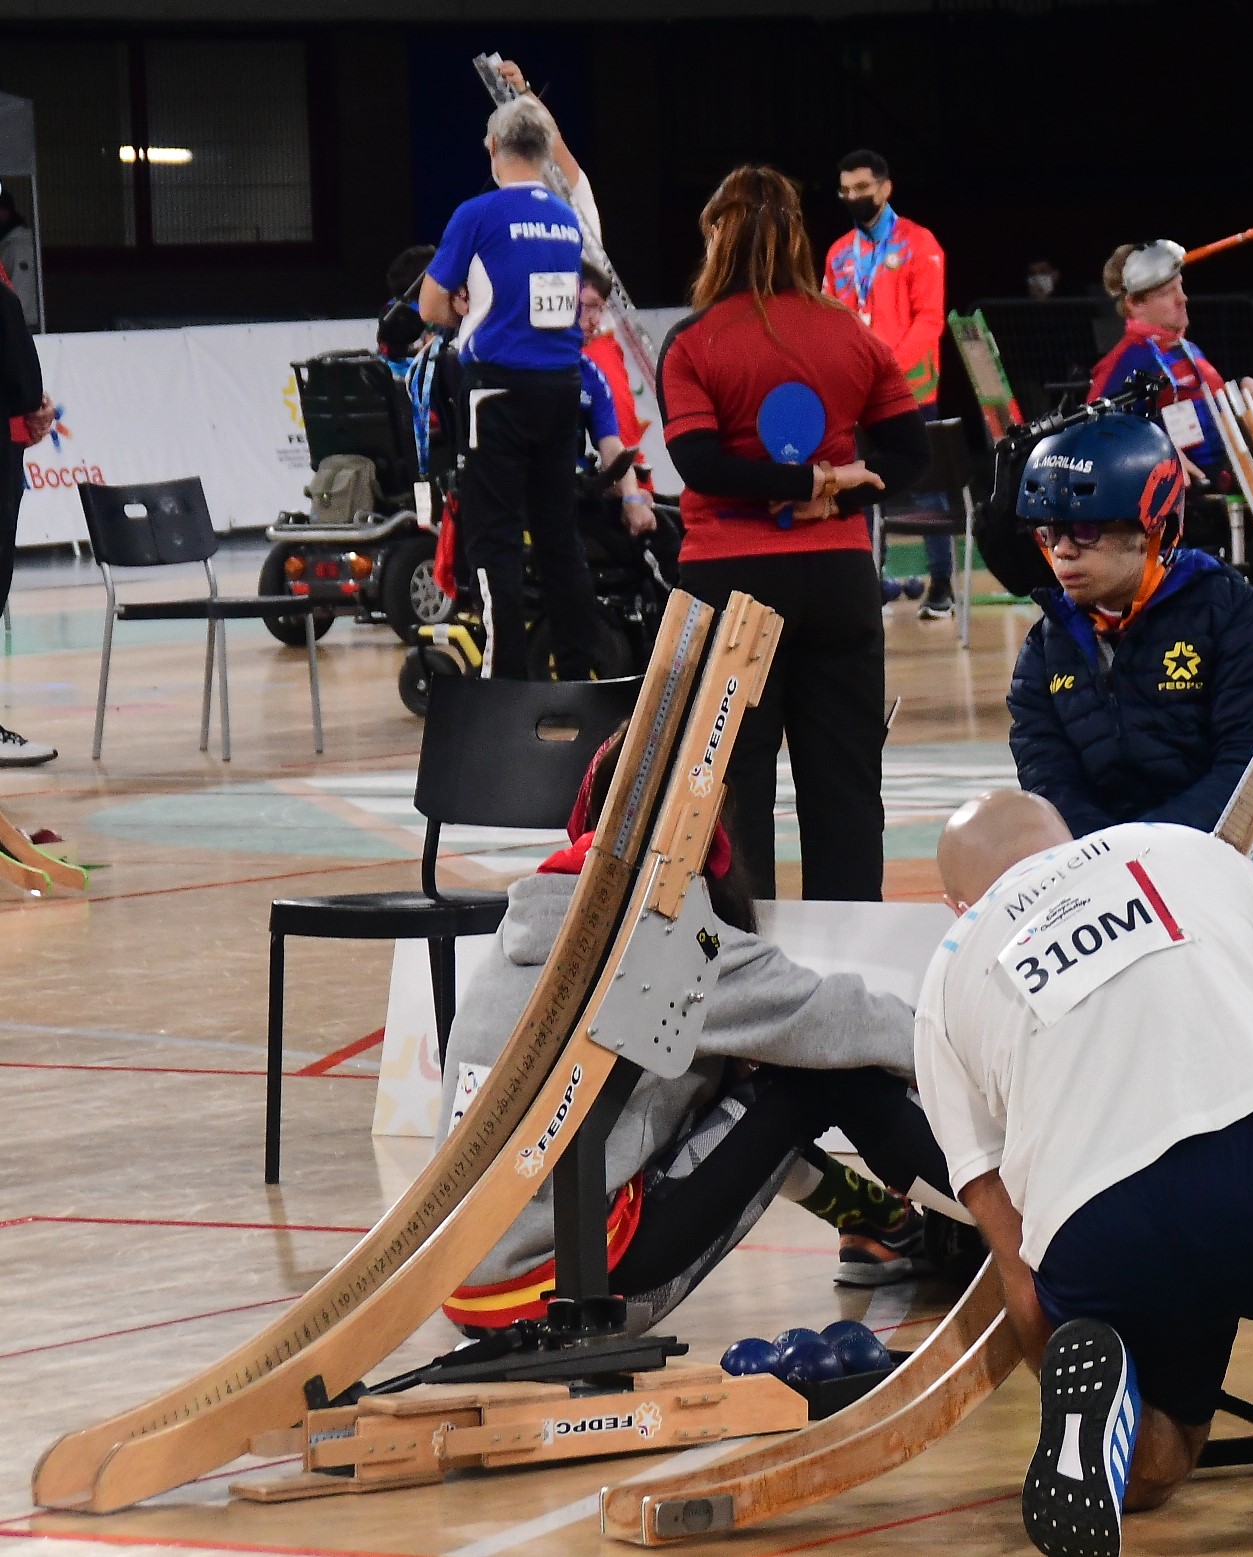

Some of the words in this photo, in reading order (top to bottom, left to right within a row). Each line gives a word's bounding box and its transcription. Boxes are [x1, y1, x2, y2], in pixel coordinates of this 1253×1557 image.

[510, 222, 580, 242] FINLAND
[533, 296, 575, 312] 317M
[27, 460, 105, 489] Boccia
[703, 678, 738, 766] FEDPC
[1015, 898, 1153, 995] 310M
[537, 1065, 581, 1151] FEDPC
[556, 1415, 633, 1434] FEDPC
